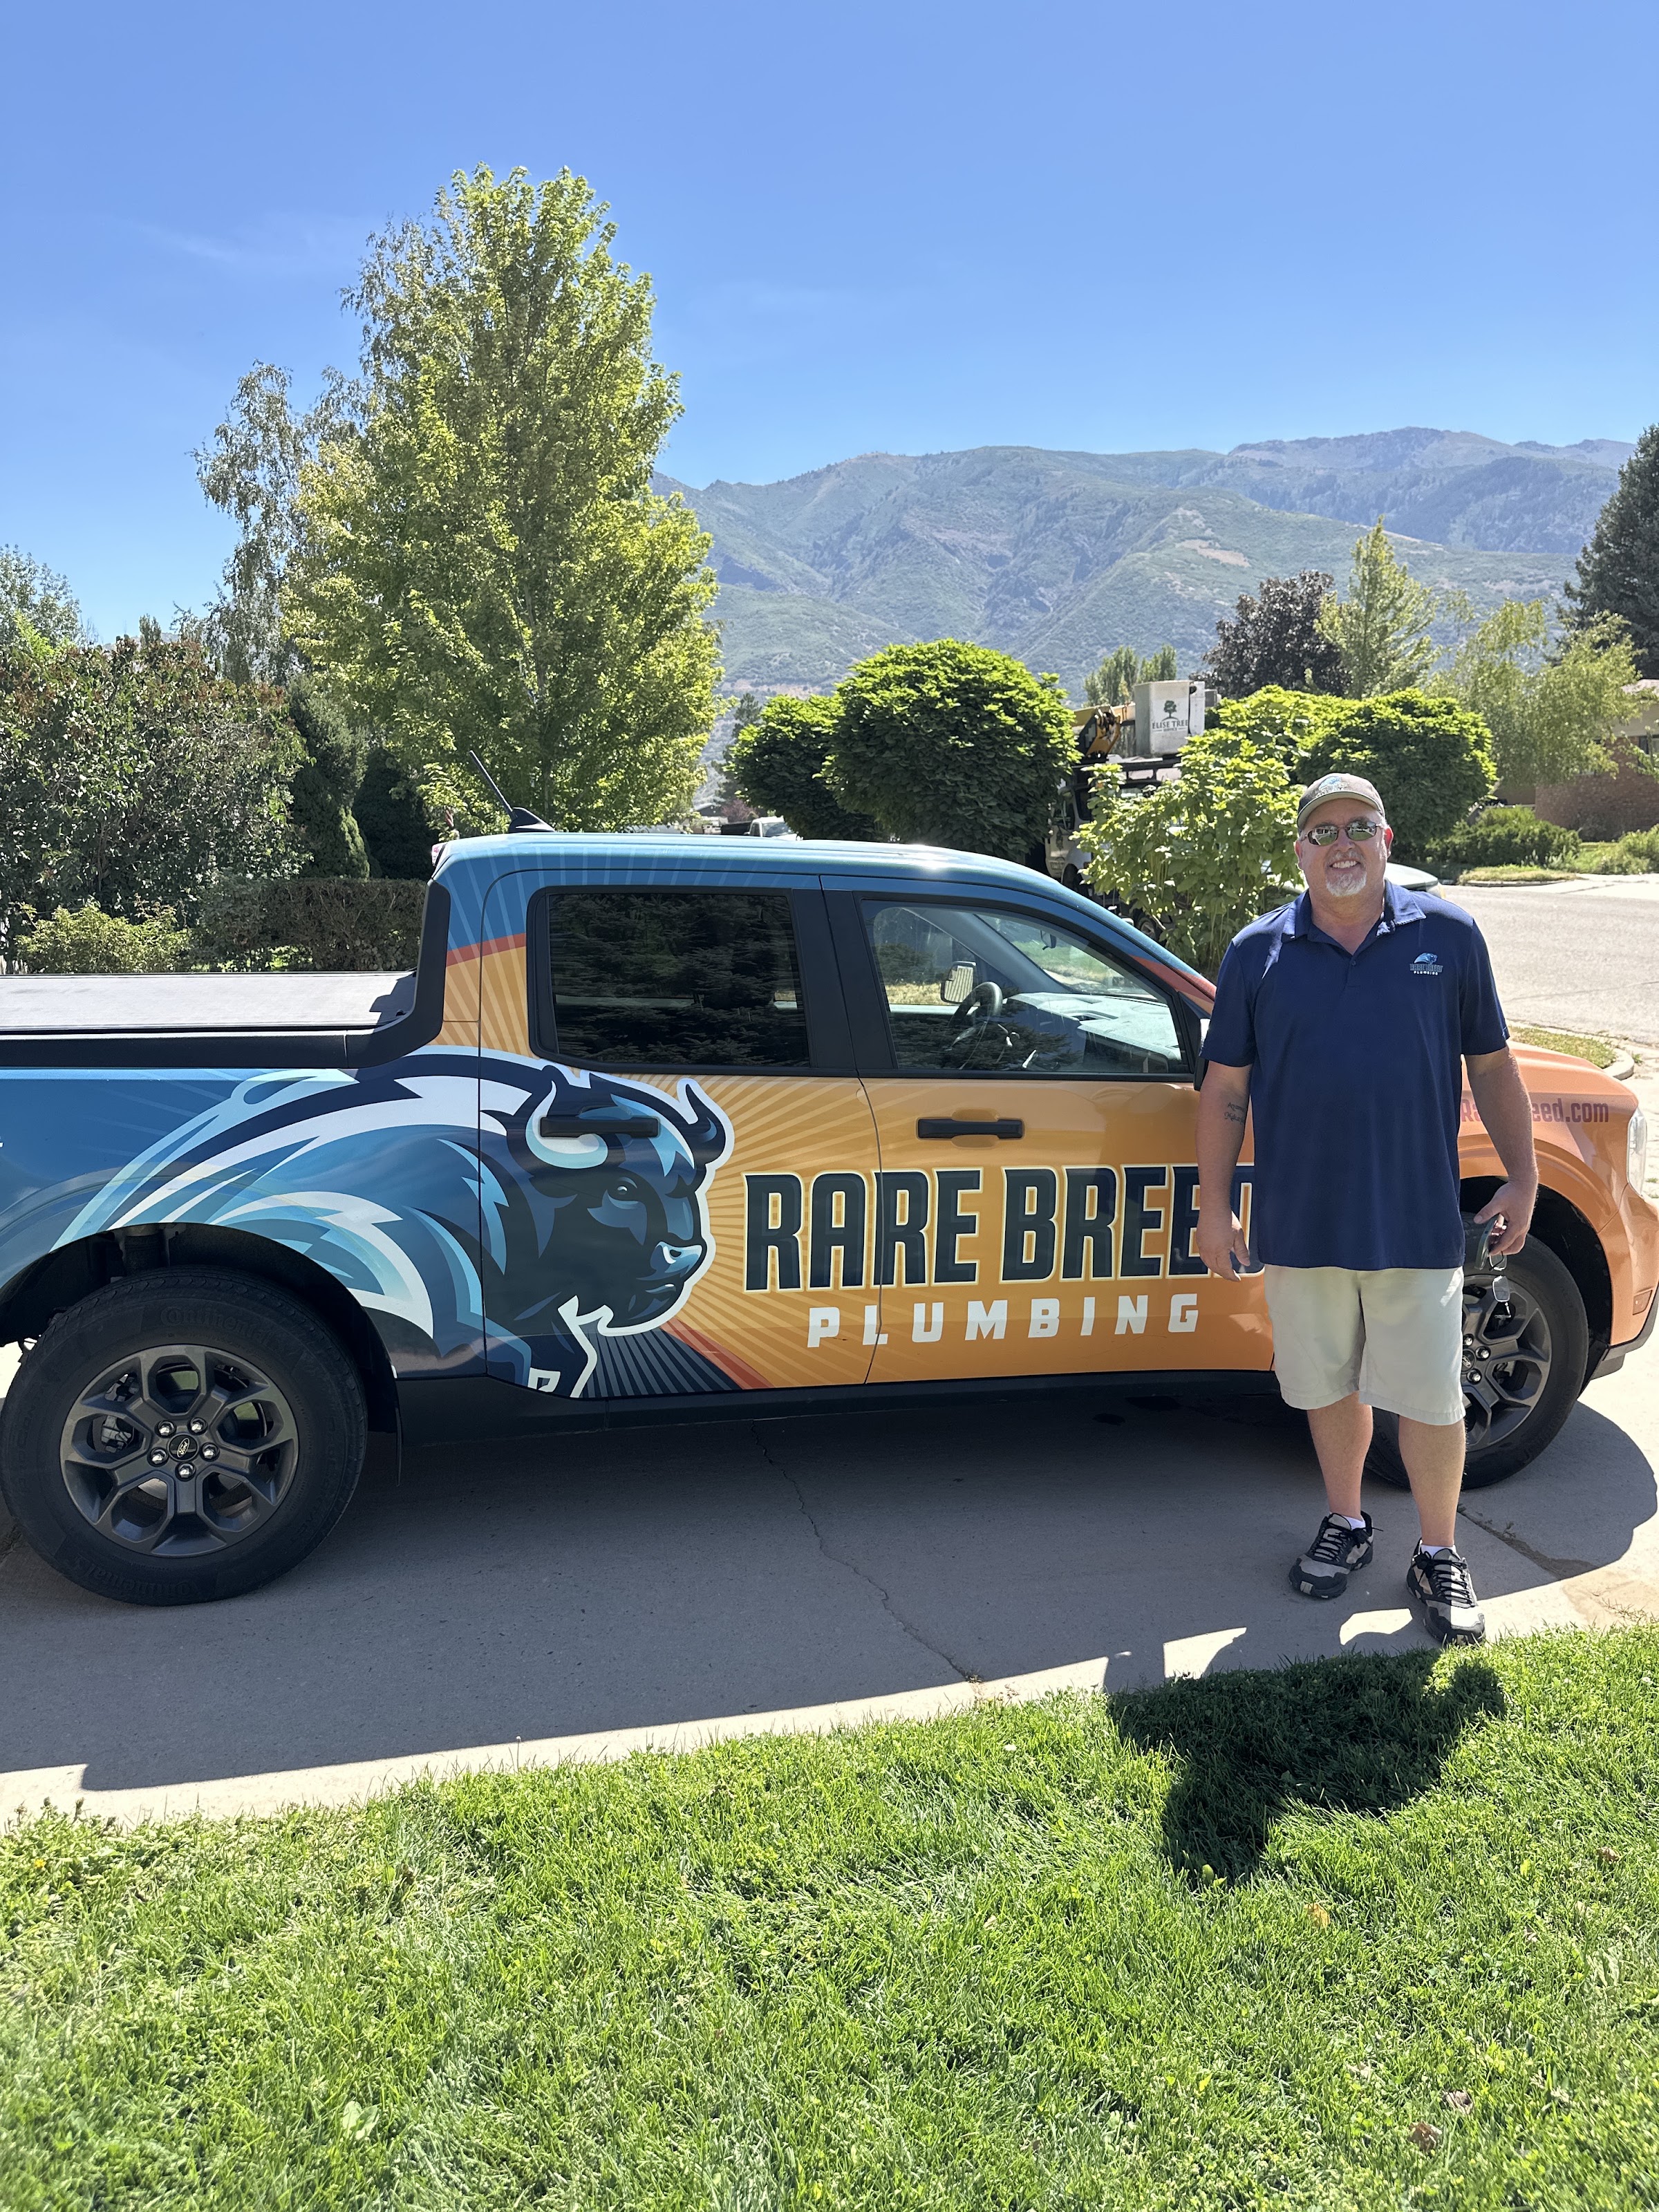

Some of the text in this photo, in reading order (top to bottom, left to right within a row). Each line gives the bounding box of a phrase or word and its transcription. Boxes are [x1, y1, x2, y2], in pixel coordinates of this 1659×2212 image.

[1152, 721, 1170, 729] ELISE
[1461, 1098, 1609, 1123] Reed.com
[741, 1166, 984, 1293] RARE
[807, 1293, 1199, 1348] PLUMBING
